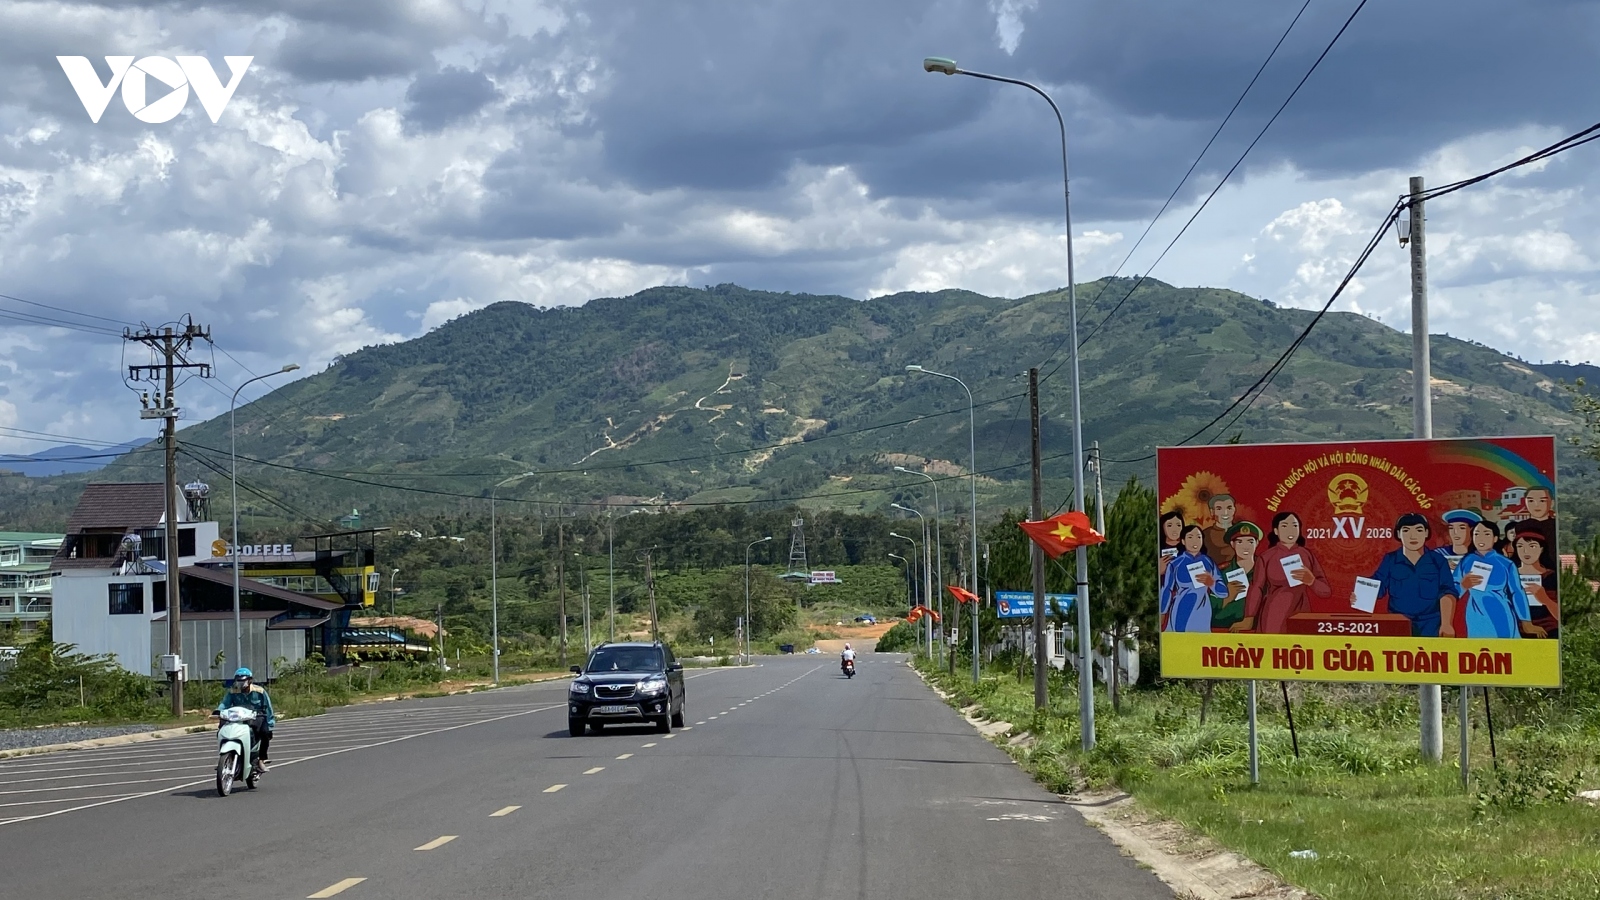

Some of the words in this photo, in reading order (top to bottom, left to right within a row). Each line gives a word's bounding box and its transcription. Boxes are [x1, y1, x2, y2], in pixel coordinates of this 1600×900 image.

[1284, 467, 1305, 488] QUỐC
[1303, 459, 1319, 474] HỘI
[1317, 453, 1330, 468] VÀ
[1330, 450, 1344, 467] HỘI
[1345, 447, 1368, 465] ĐỒNG
[1369, 455, 1391, 473] NHÂN
[1389, 465, 1408, 482] DÂN
[1404, 477, 1421, 495] CÁC
[1416, 493, 1434, 509] CẤP
[1306, 528, 1331, 539] 2021
[1332, 516, 1365, 539] XV
[1366, 527, 1392, 539] 2026
[1317, 622, 1380, 634] 23-5-2021
[1202, 643, 1265, 669] NGÀY
[1272, 644, 1314, 674] HỘI
[1323, 643, 1375, 672] CỦA
[1382, 646, 1449, 673] TOÀN
[1458, 647, 1512, 675] DÂN
